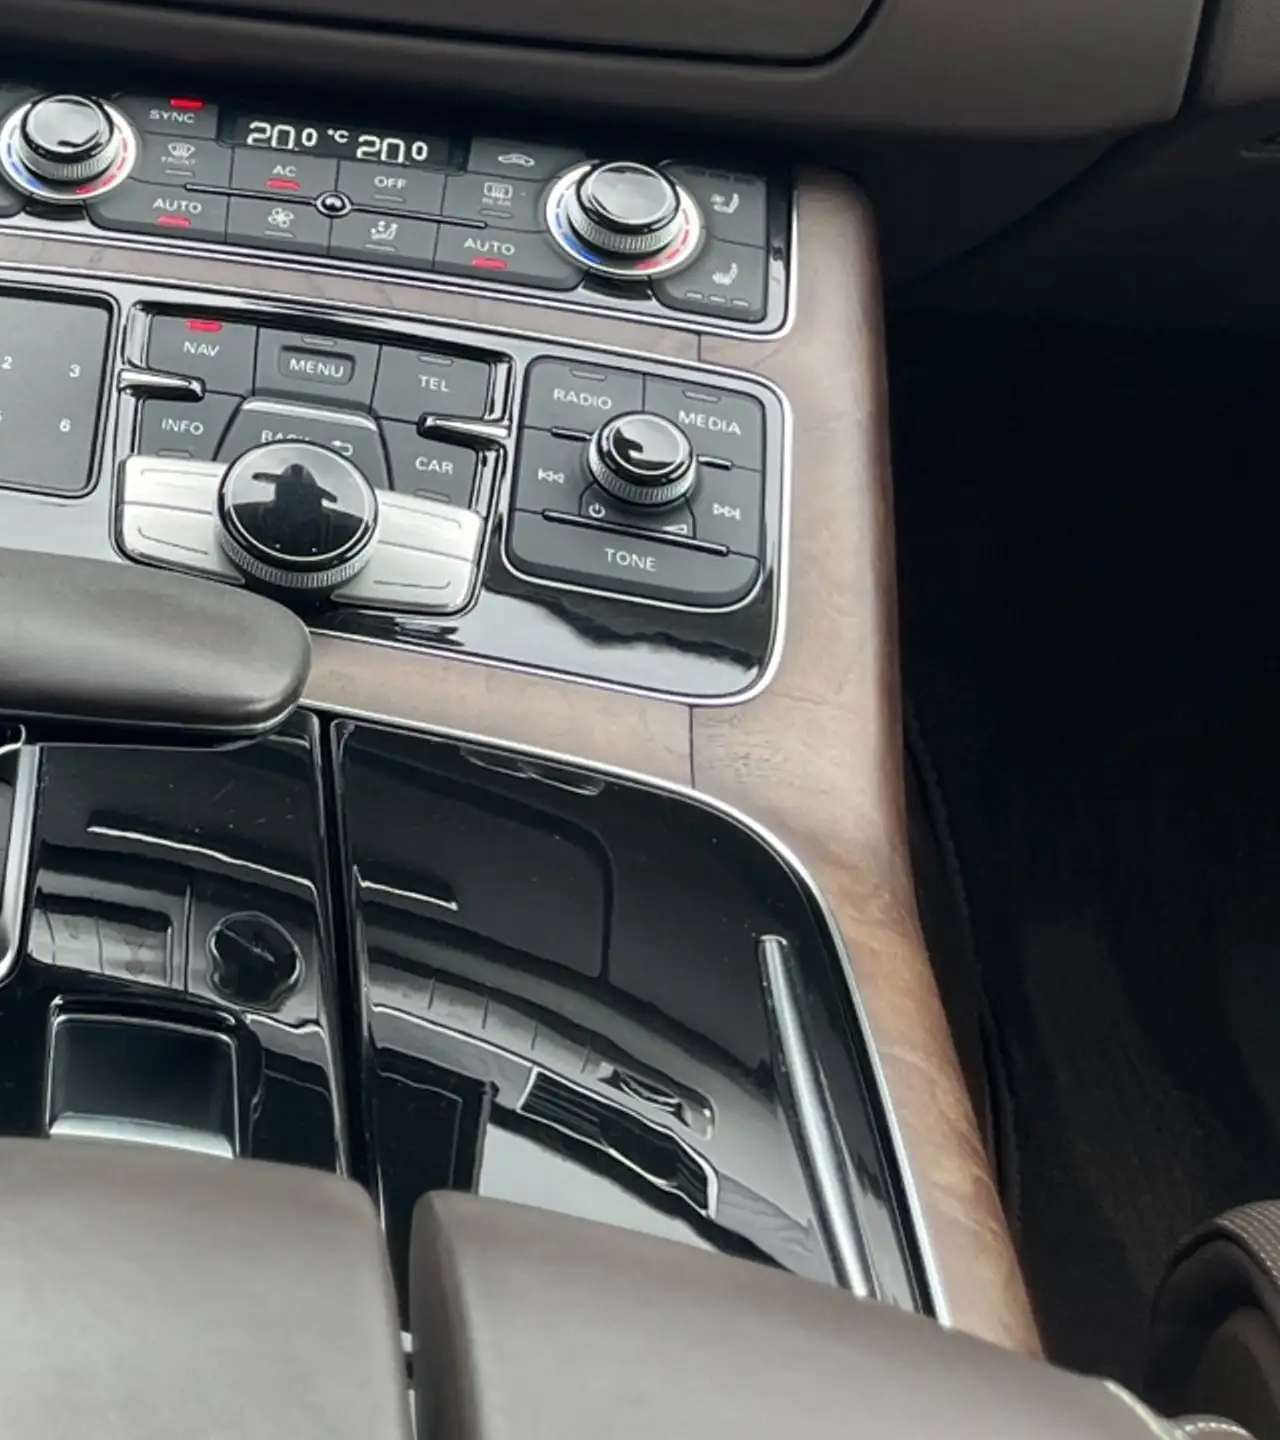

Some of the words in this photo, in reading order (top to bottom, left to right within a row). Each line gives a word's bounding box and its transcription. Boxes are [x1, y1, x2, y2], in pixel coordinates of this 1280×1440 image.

[149, 109, 195, 124] SYNC
[272, 164, 298, 178] AC
[373, 176, 407, 190] OFF
[152, 197, 203, 214] AUTO
[463, 237, 516, 256] AUTO
[183, 340, 221, 358] NAV
[0, 356, 13, 370] 2
[68, 364, 82, 378] 3
[289, 357, 344, 378] MENU
[417, 374, 450, 393] TEL
[552, 388, 614, 411] RADIO
[58, 418, 72, 432] 6
[161, 417, 204, 436] INFO
[677, 410, 742, 436] MEDIA
[414, 456, 454, 476] CAR
[603, 547, 657, 572] TONE
